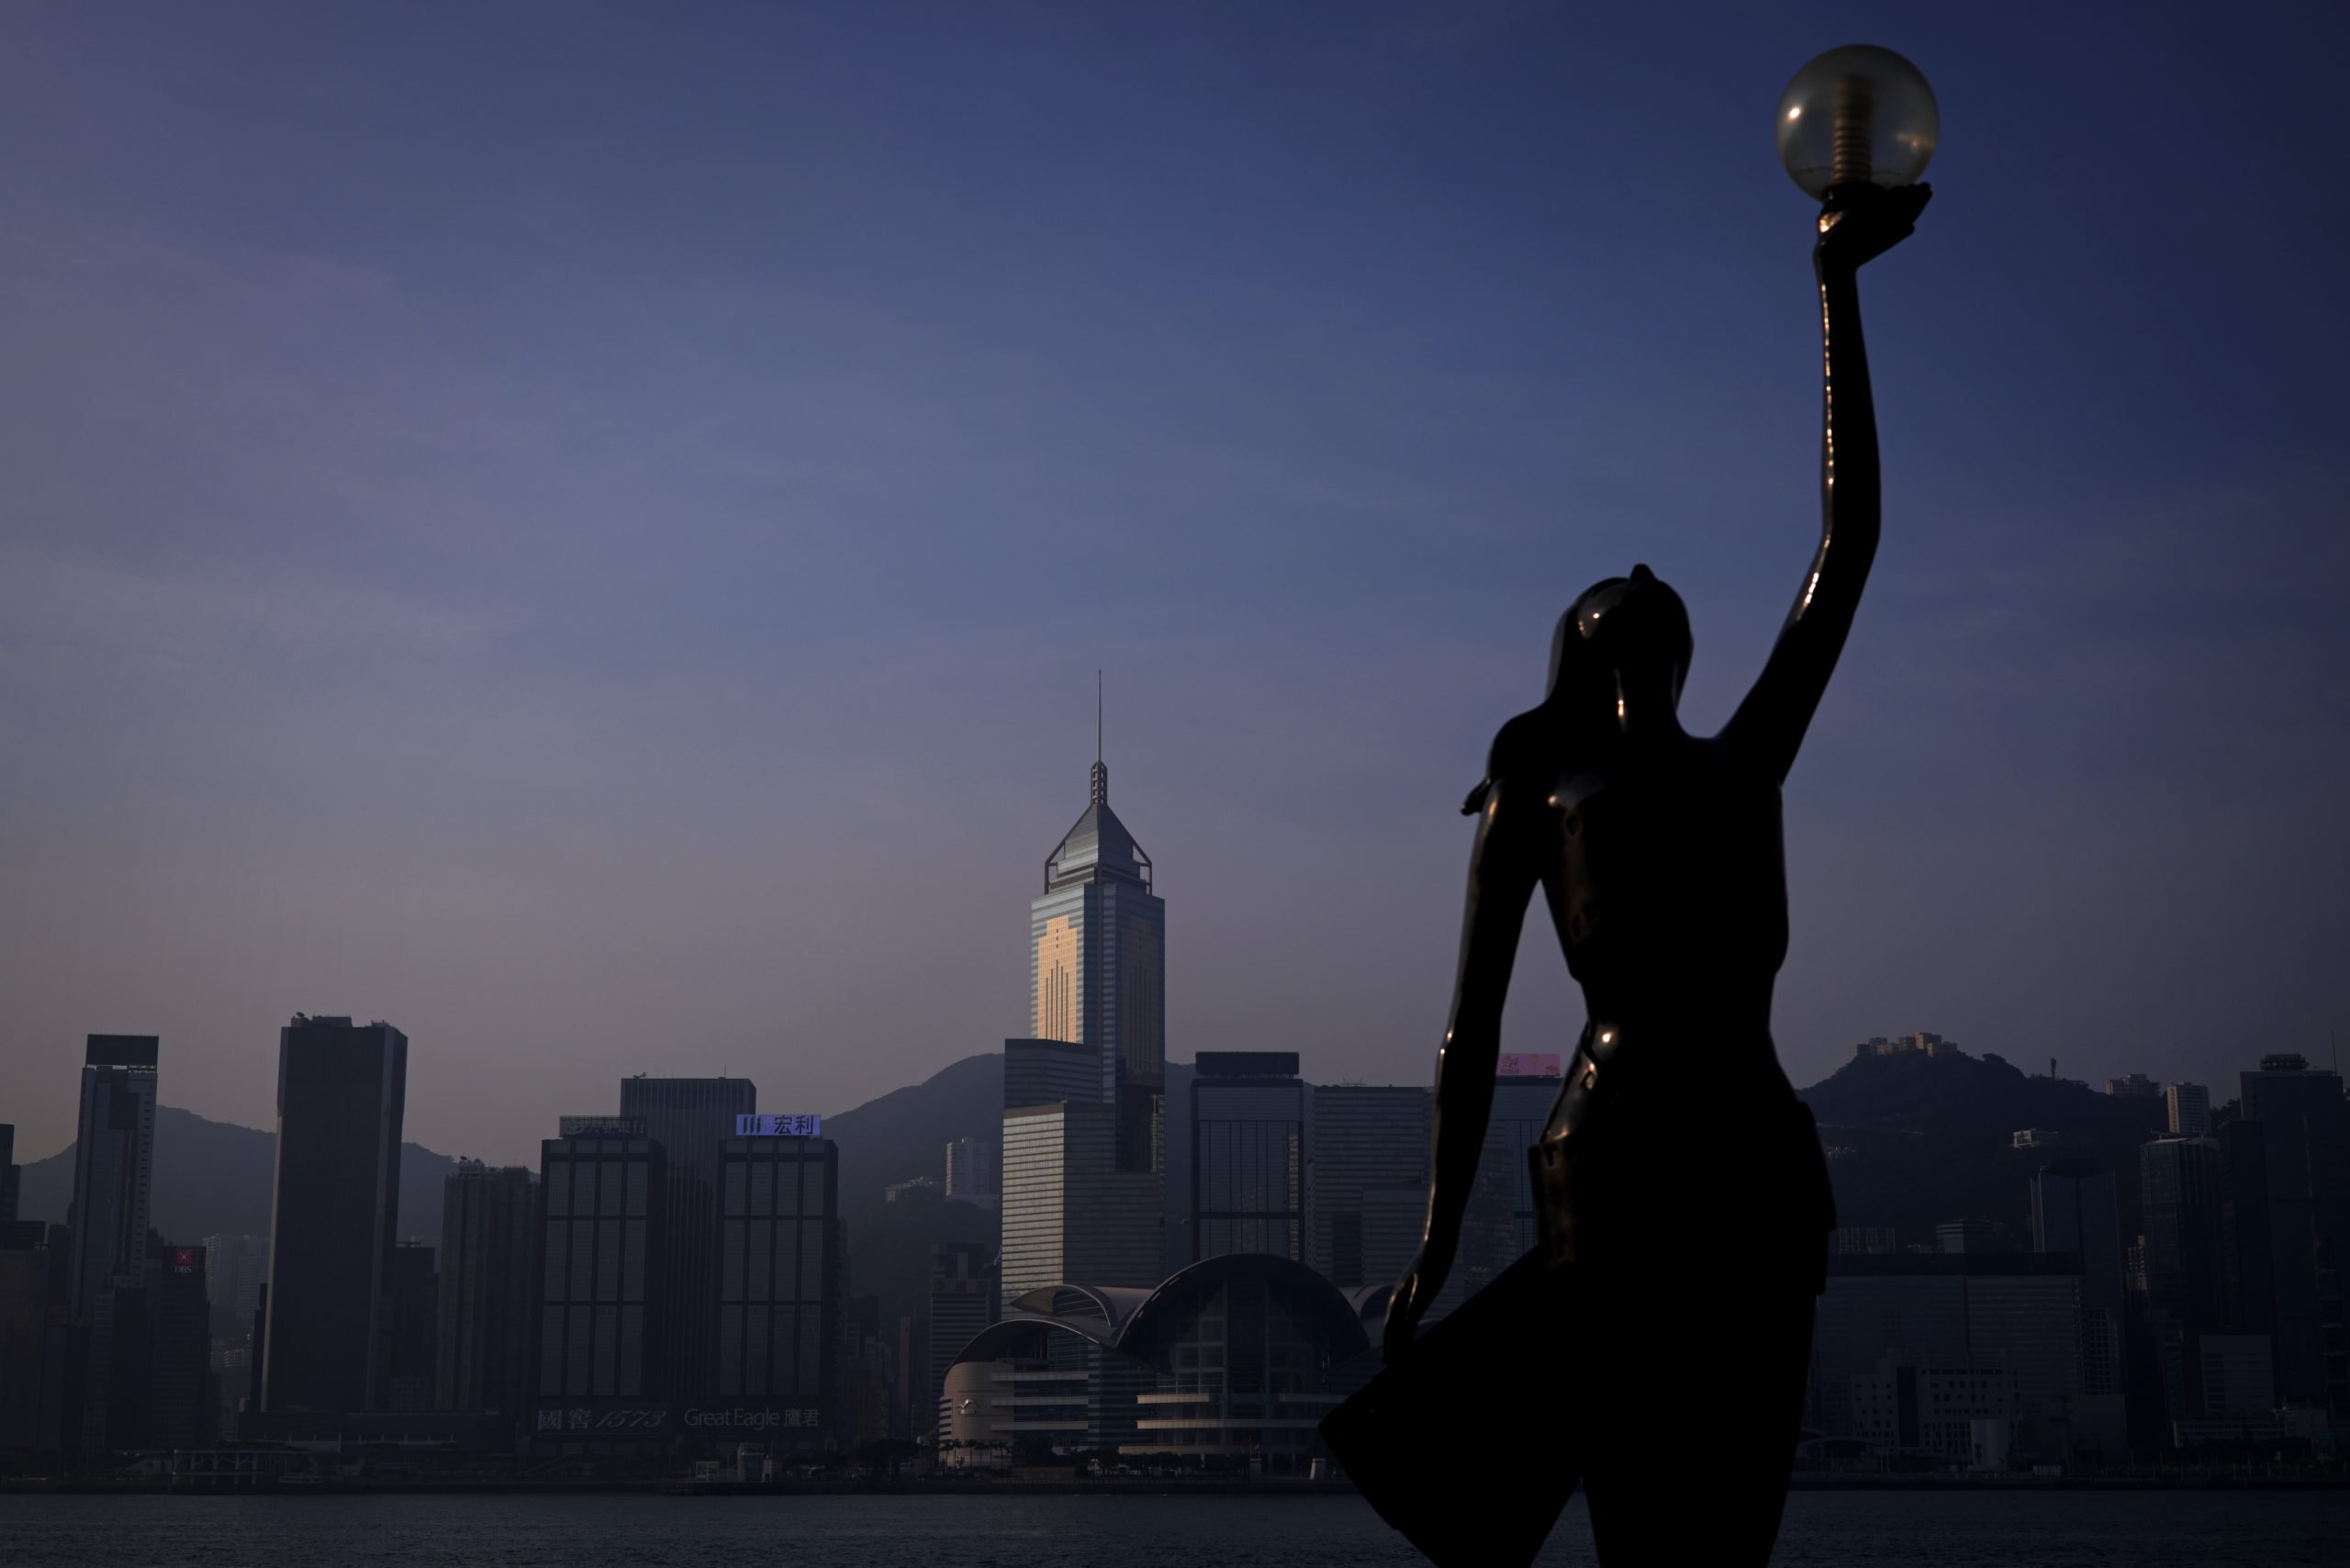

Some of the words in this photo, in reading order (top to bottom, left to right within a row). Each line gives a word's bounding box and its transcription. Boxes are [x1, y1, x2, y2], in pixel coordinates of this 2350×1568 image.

[773, 1115, 813, 1134] 宏利
[684, 1408, 732, 1426] Great
[733, 1406, 780, 1431] Eagle
[783, 1408, 821, 1428] 鷹君
